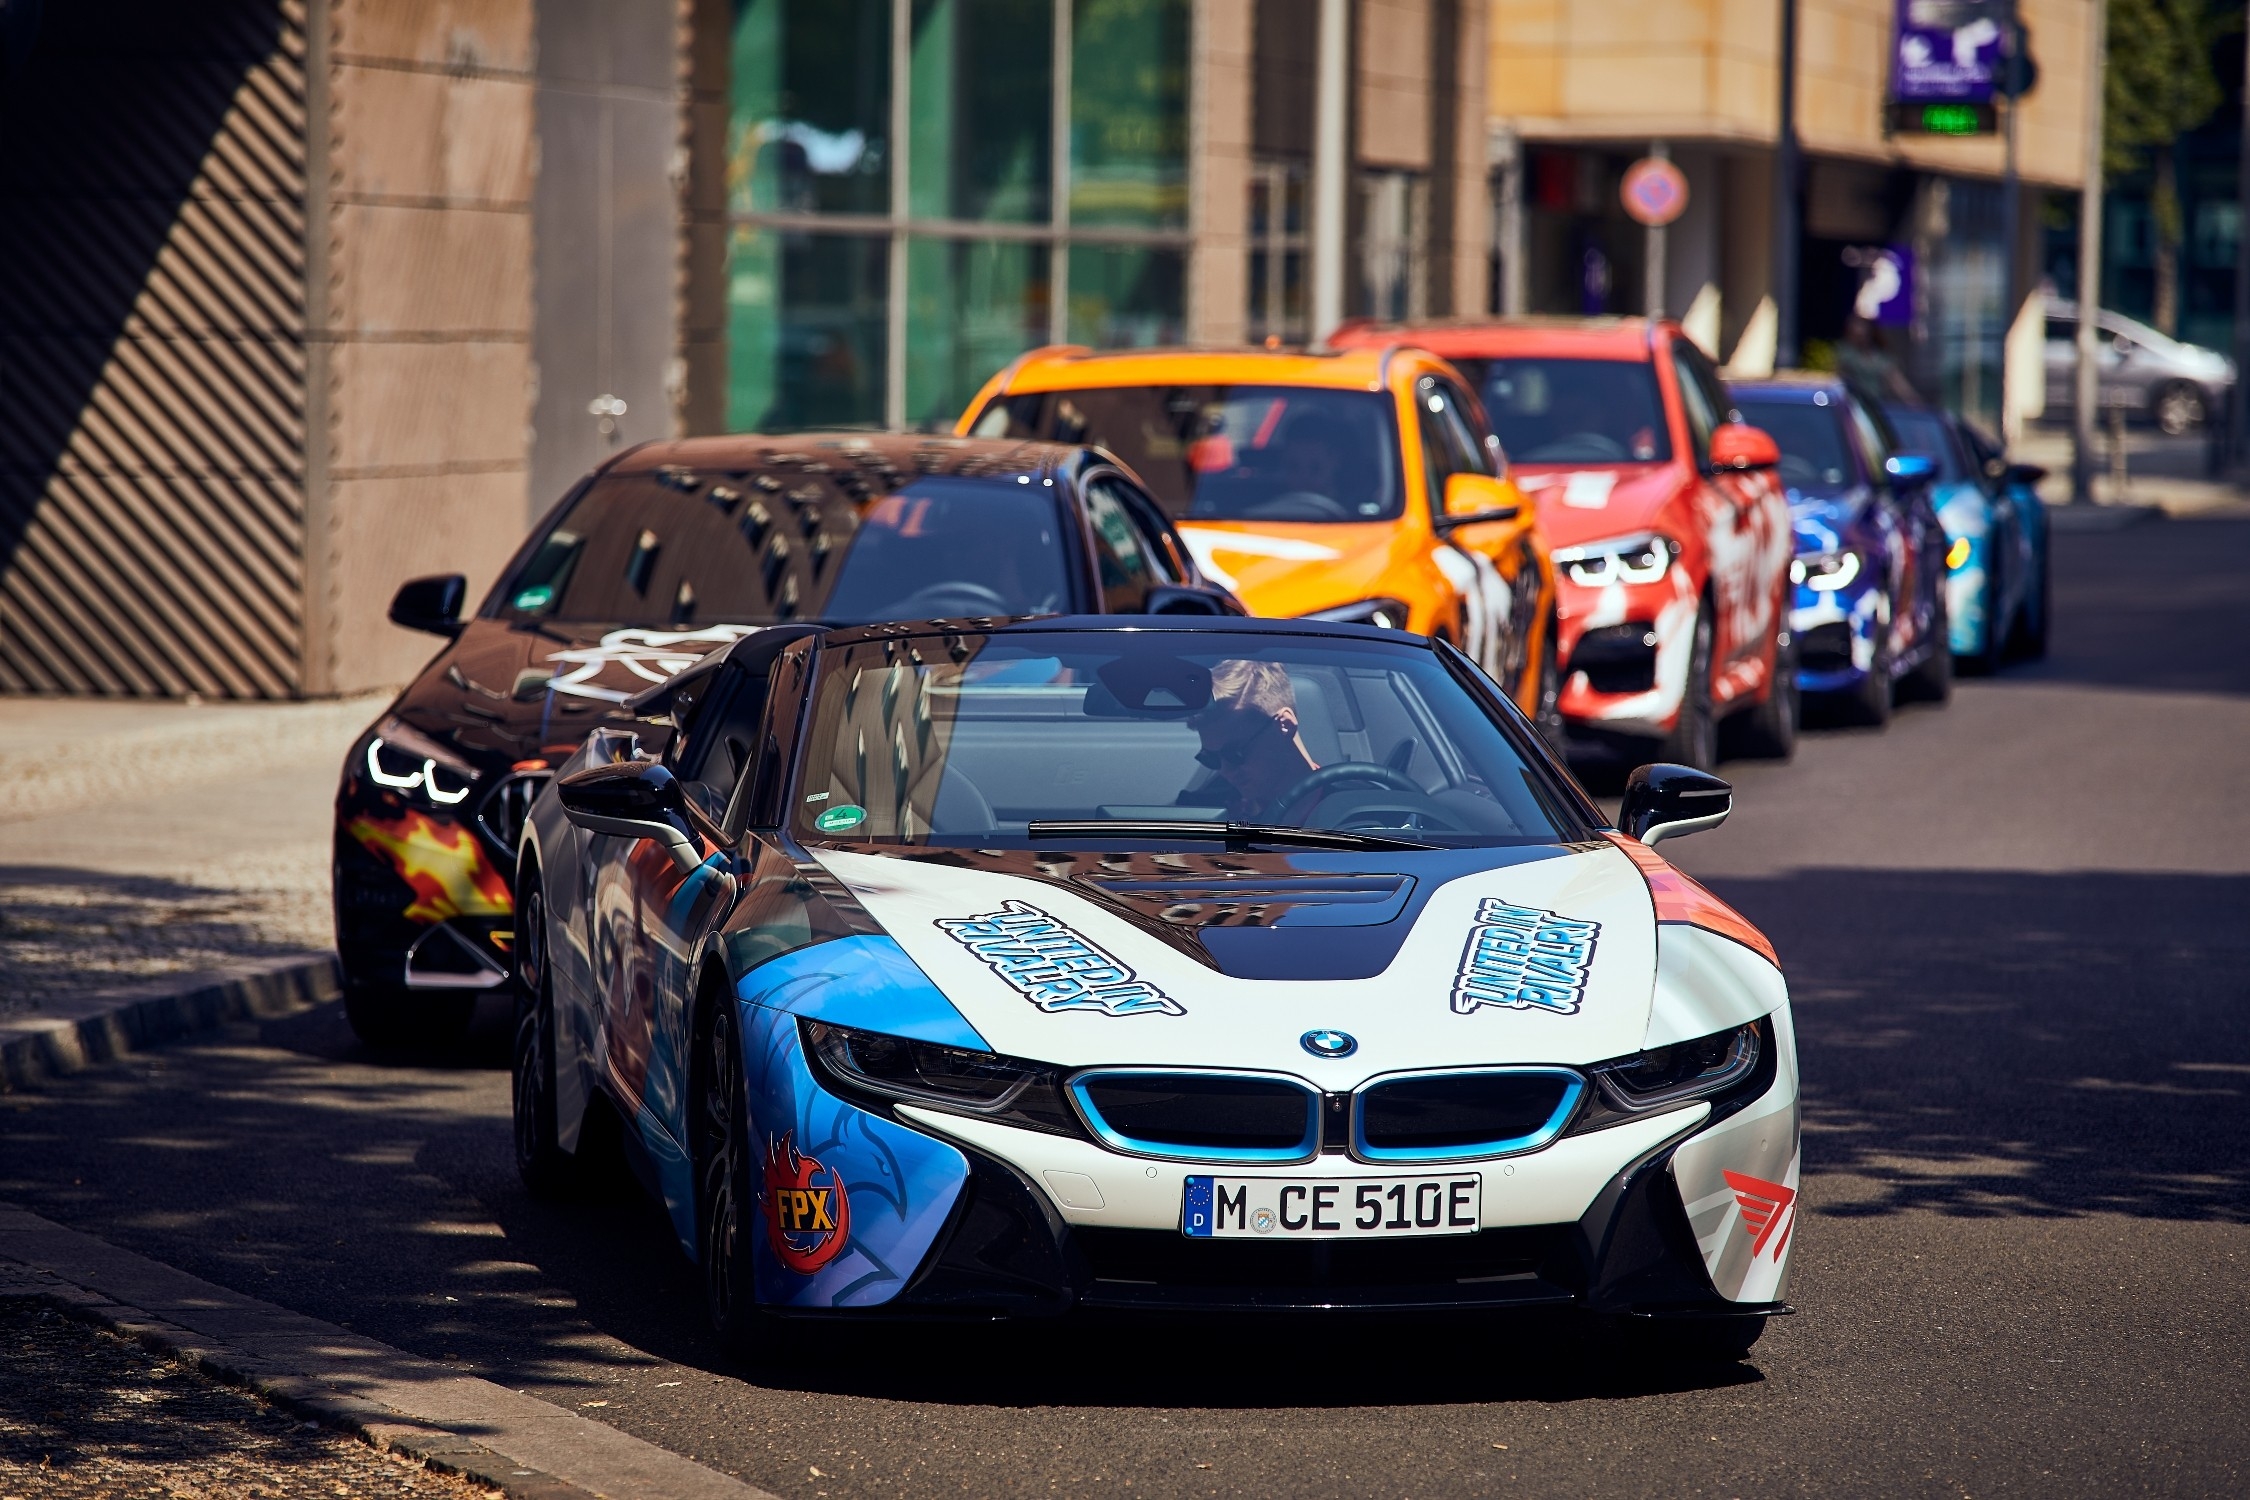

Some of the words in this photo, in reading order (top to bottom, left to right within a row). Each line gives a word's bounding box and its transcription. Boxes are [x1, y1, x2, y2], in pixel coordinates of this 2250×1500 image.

[1485, 899, 1542, 932] IN
[940, 920, 1112, 1012] RIVALRY
[989, 902, 1128, 988] UNITED
[1093, 983, 1180, 1016] IN
[1461, 928, 1534, 1010] UNITED
[1516, 914, 1592, 1013] RIVALRY
[776, 1189, 834, 1230] FPX
[1193, 1213, 1204, 1227] D
[1217, 1185, 1247, 1230] M
[1279, 1185, 1340, 1230] CE
[1355, 1181, 1476, 1230] 510E
